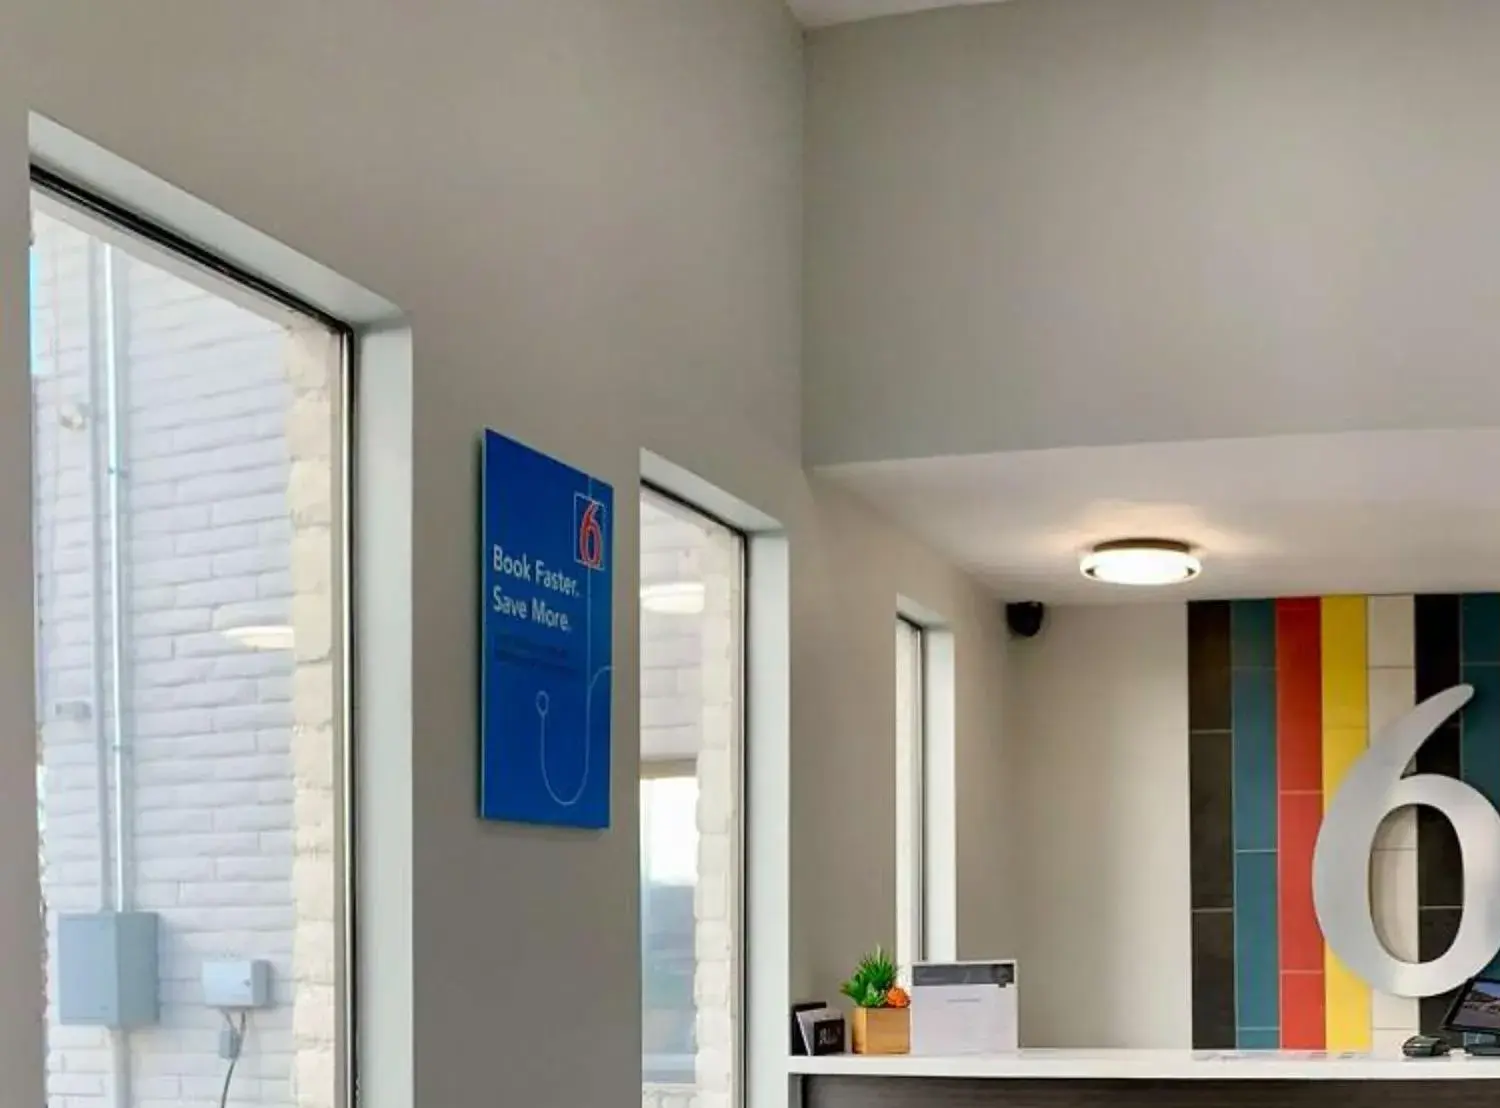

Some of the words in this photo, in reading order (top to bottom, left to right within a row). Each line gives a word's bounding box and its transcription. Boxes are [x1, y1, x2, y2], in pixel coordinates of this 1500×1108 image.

[580, 500, 601, 568] 6
[493, 543, 531, 581] Book
[535, 560, 580, 598] Faster.
[493, 585, 528, 619] Save
[532, 597, 572, 632] More.
